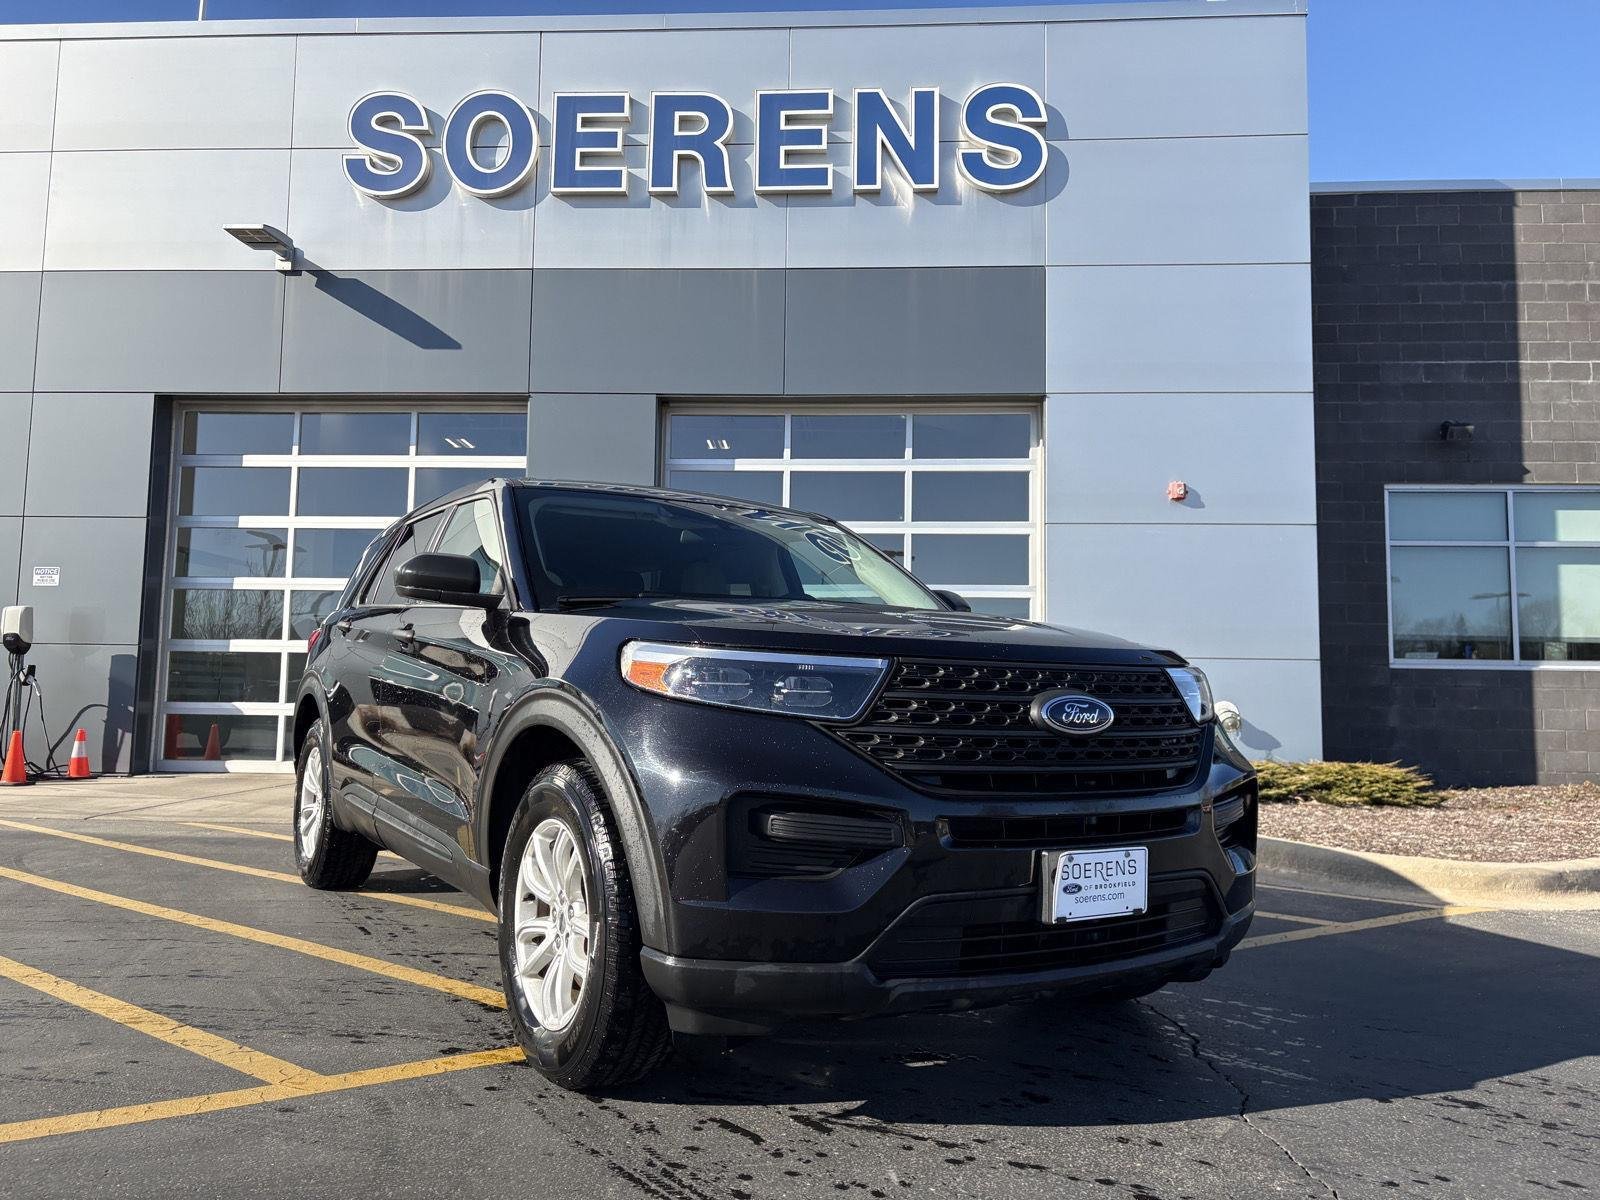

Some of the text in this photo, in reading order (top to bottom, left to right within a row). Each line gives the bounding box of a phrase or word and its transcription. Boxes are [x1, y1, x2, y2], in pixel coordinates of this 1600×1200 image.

[342, 82, 1049, 198] SOERENS
[1062, 702, 1099, 724] Ford
[1061, 859, 1137, 882] SOERENS
[1094, 881, 1136, 890] BROOKFIELD
[1074, 892, 1125, 904] soerens.com
